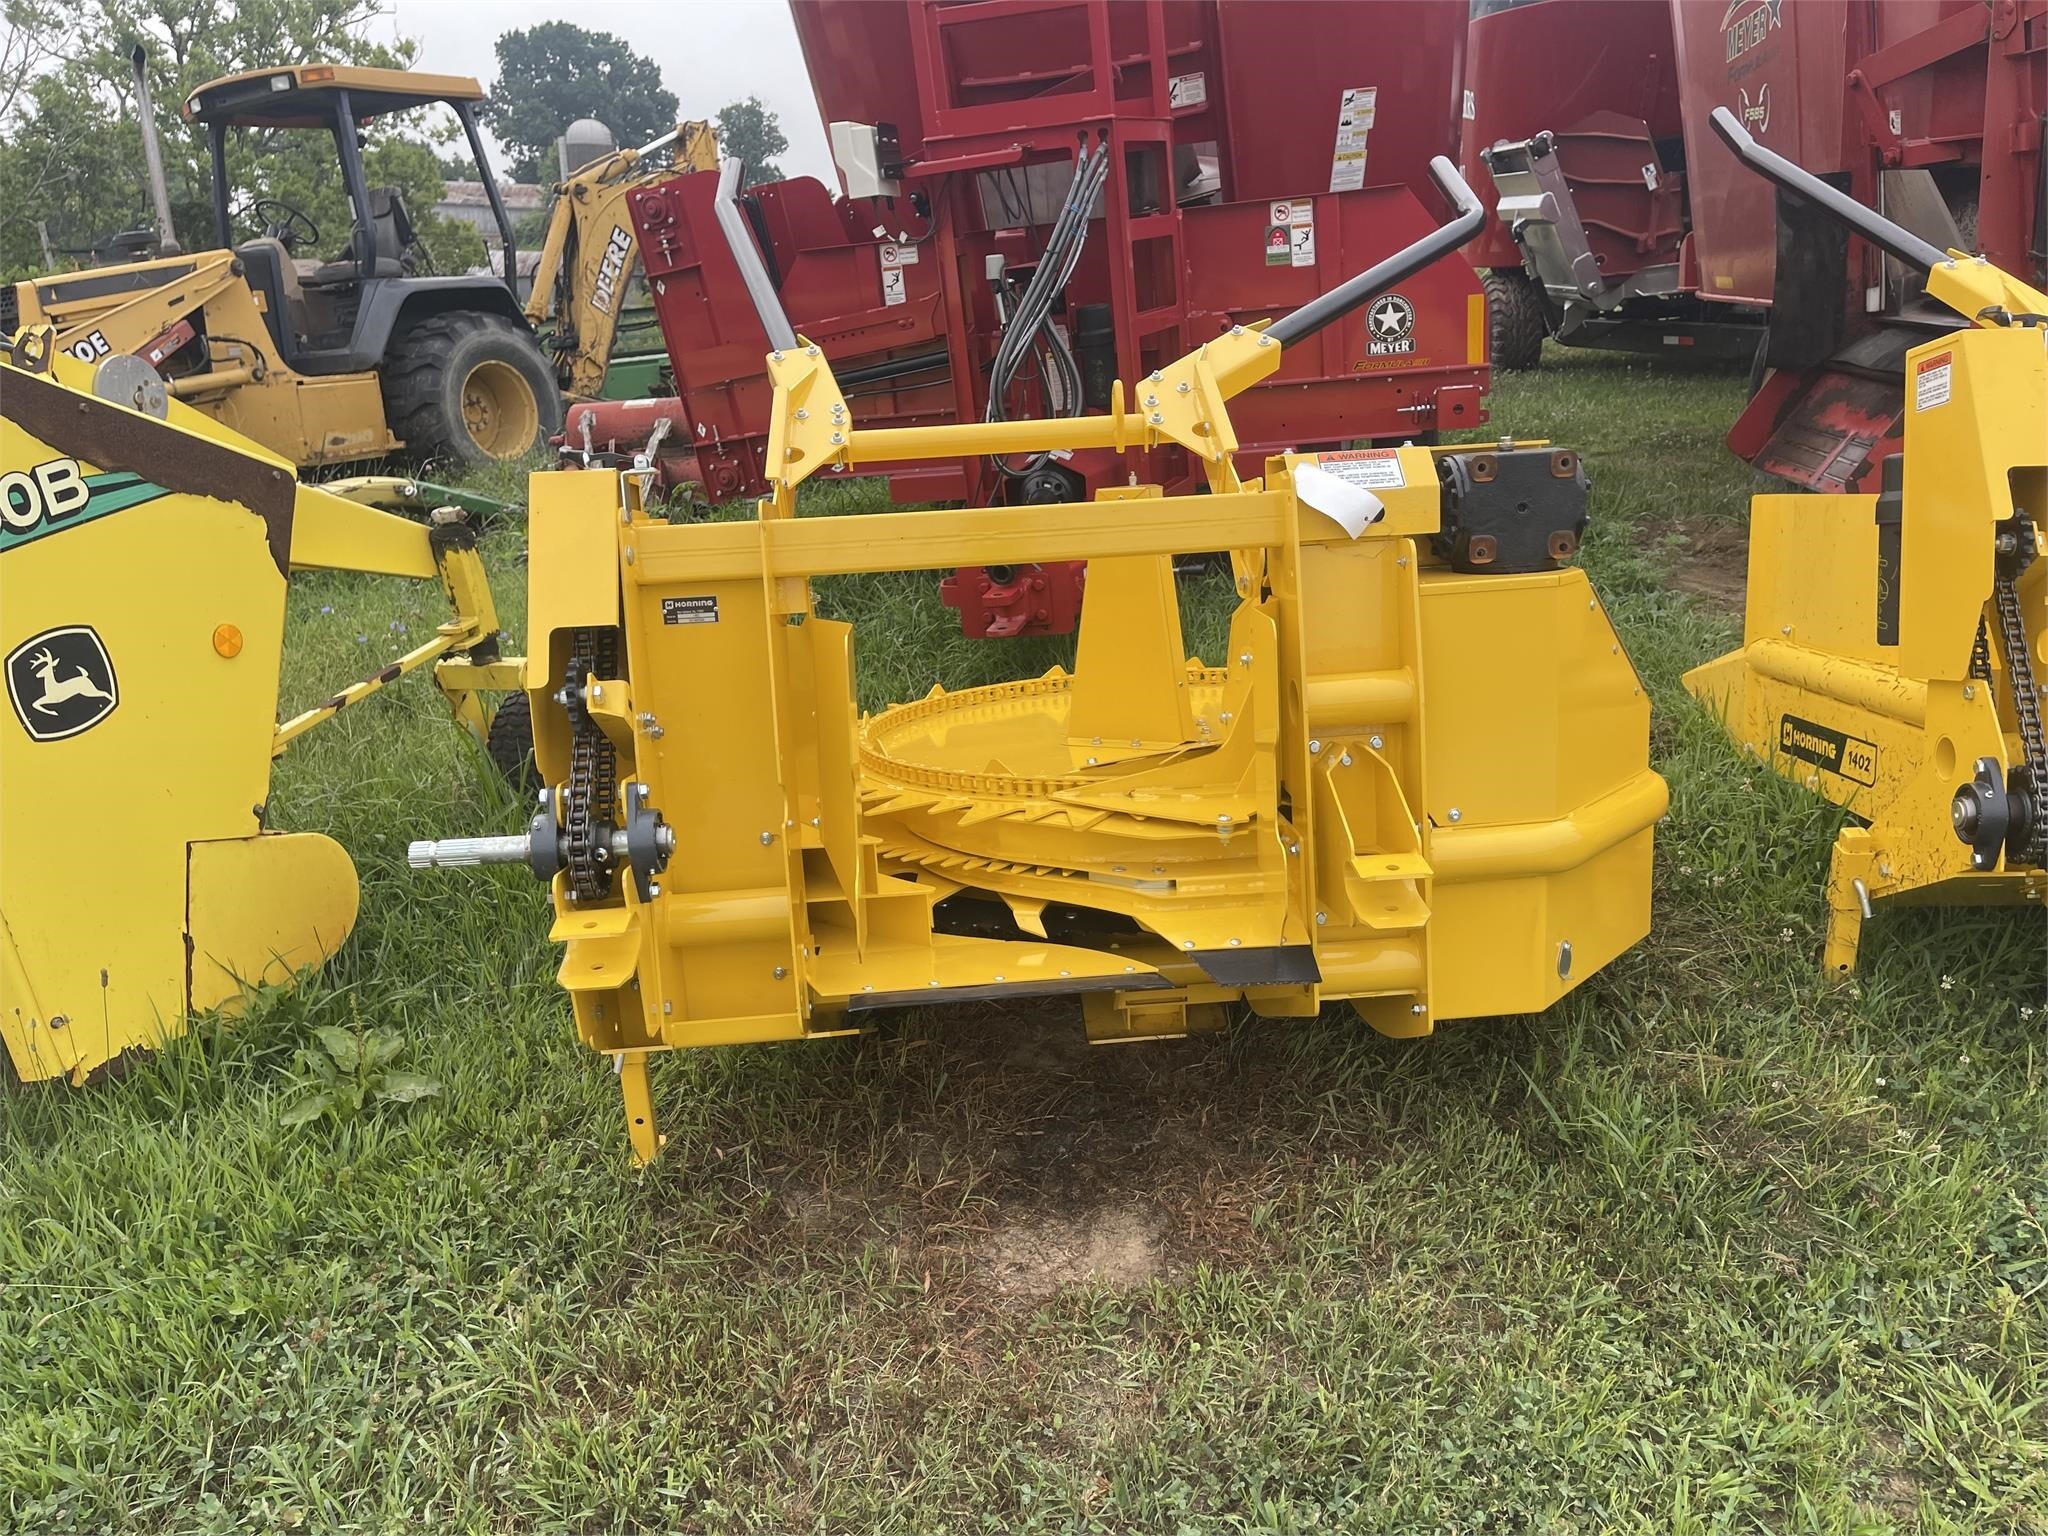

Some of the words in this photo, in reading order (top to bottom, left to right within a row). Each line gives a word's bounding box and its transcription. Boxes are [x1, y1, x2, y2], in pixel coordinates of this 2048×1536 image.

[1727, 5, 1766, 63] MEYER
[591, 224, 632, 314] DEERE
[1370, 341, 1410, 354] MEYER
[1339, 451, 1389, 460] WARNING
[0, 458, 89, 534] 0B
[674, 600, 713, 608] HORNING
[1793, 729, 1836, 759] HORNING
[1848, 751, 1871, 773] 1402
